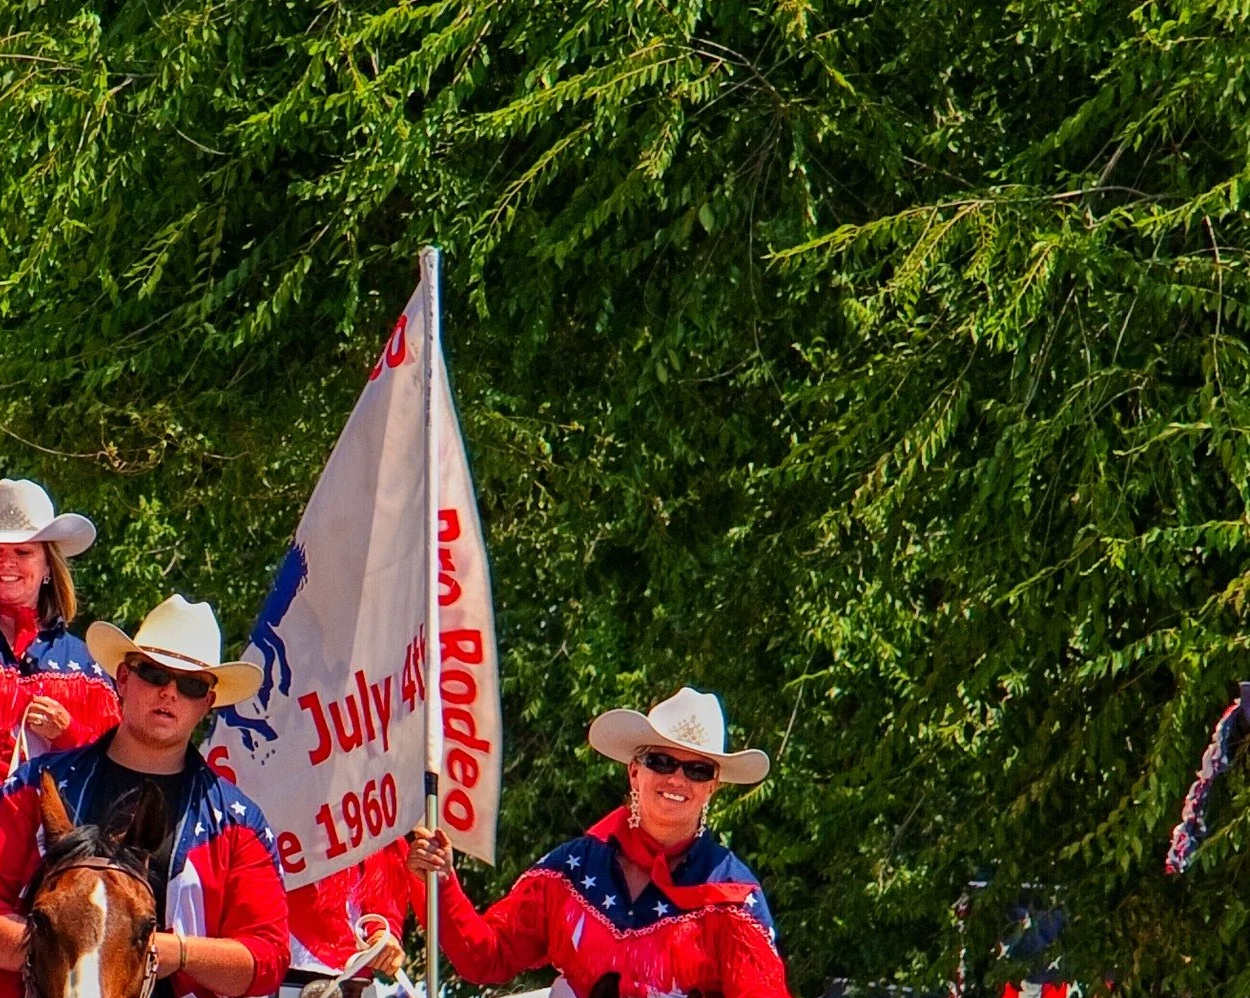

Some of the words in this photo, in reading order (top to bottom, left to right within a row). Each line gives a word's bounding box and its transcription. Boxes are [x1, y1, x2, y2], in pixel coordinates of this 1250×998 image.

[298, 669, 392, 766] July
[439, 629, 492, 833] Rodeo
[315, 772, 397, 860] 1960
